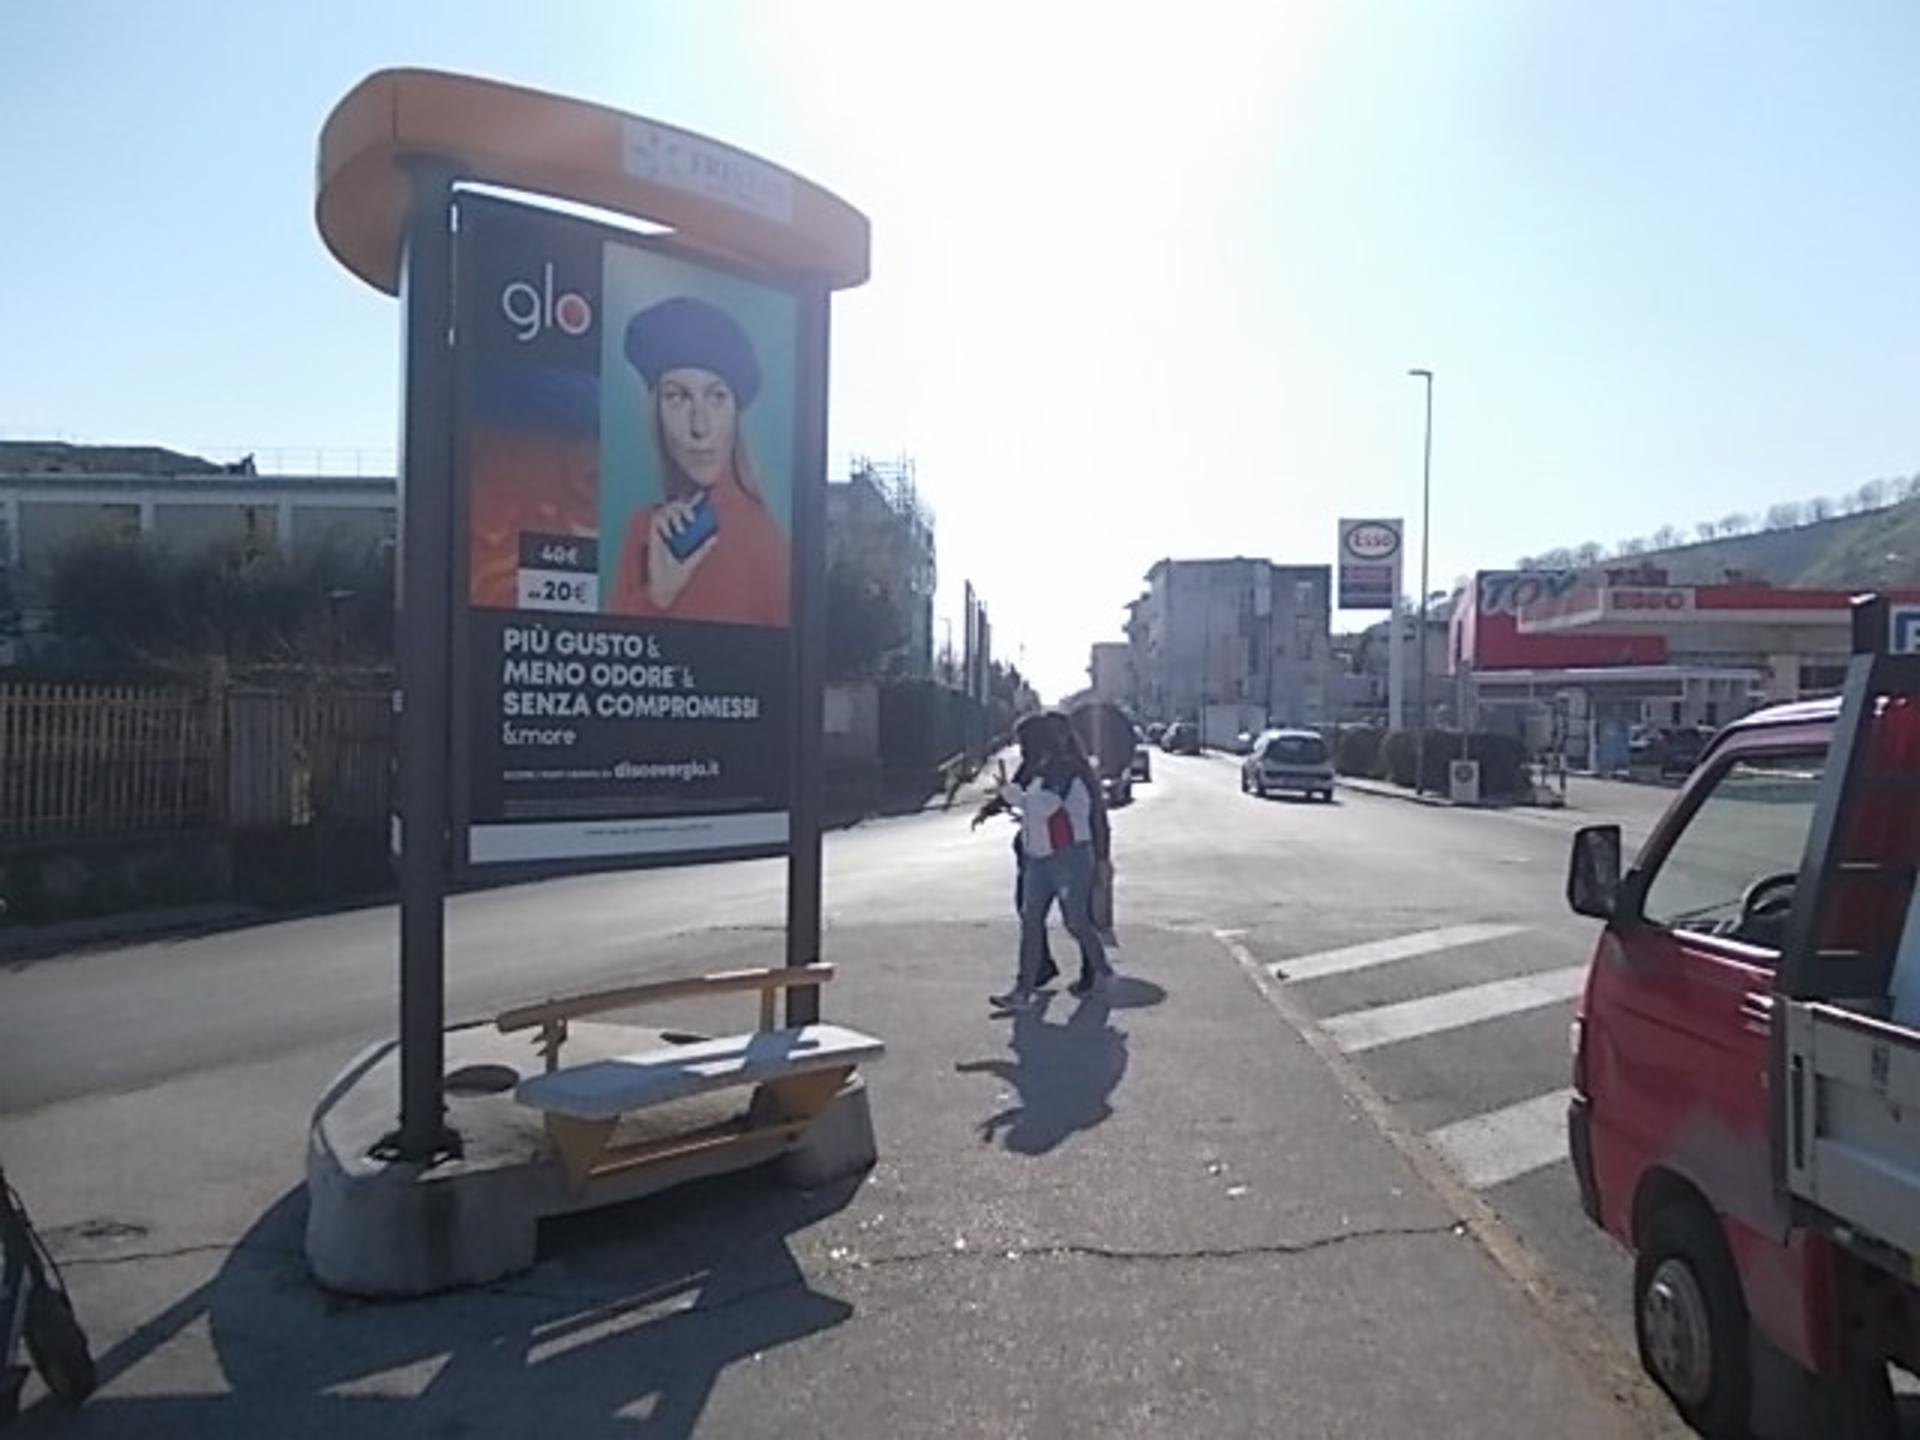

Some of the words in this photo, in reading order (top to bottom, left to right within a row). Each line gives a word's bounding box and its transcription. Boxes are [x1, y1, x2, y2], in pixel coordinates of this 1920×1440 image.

[502, 262, 592, 340] glo
[503, 624, 549, 654] PIÙ
[555, 631, 643, 657] GUSTO
[503, 661, 585, 685] MENO
[591, 664, 674, 688] ODORE
[503, 692, 590, 716] SENZA
[596, 693, 760, 718] COMPROMESSI
